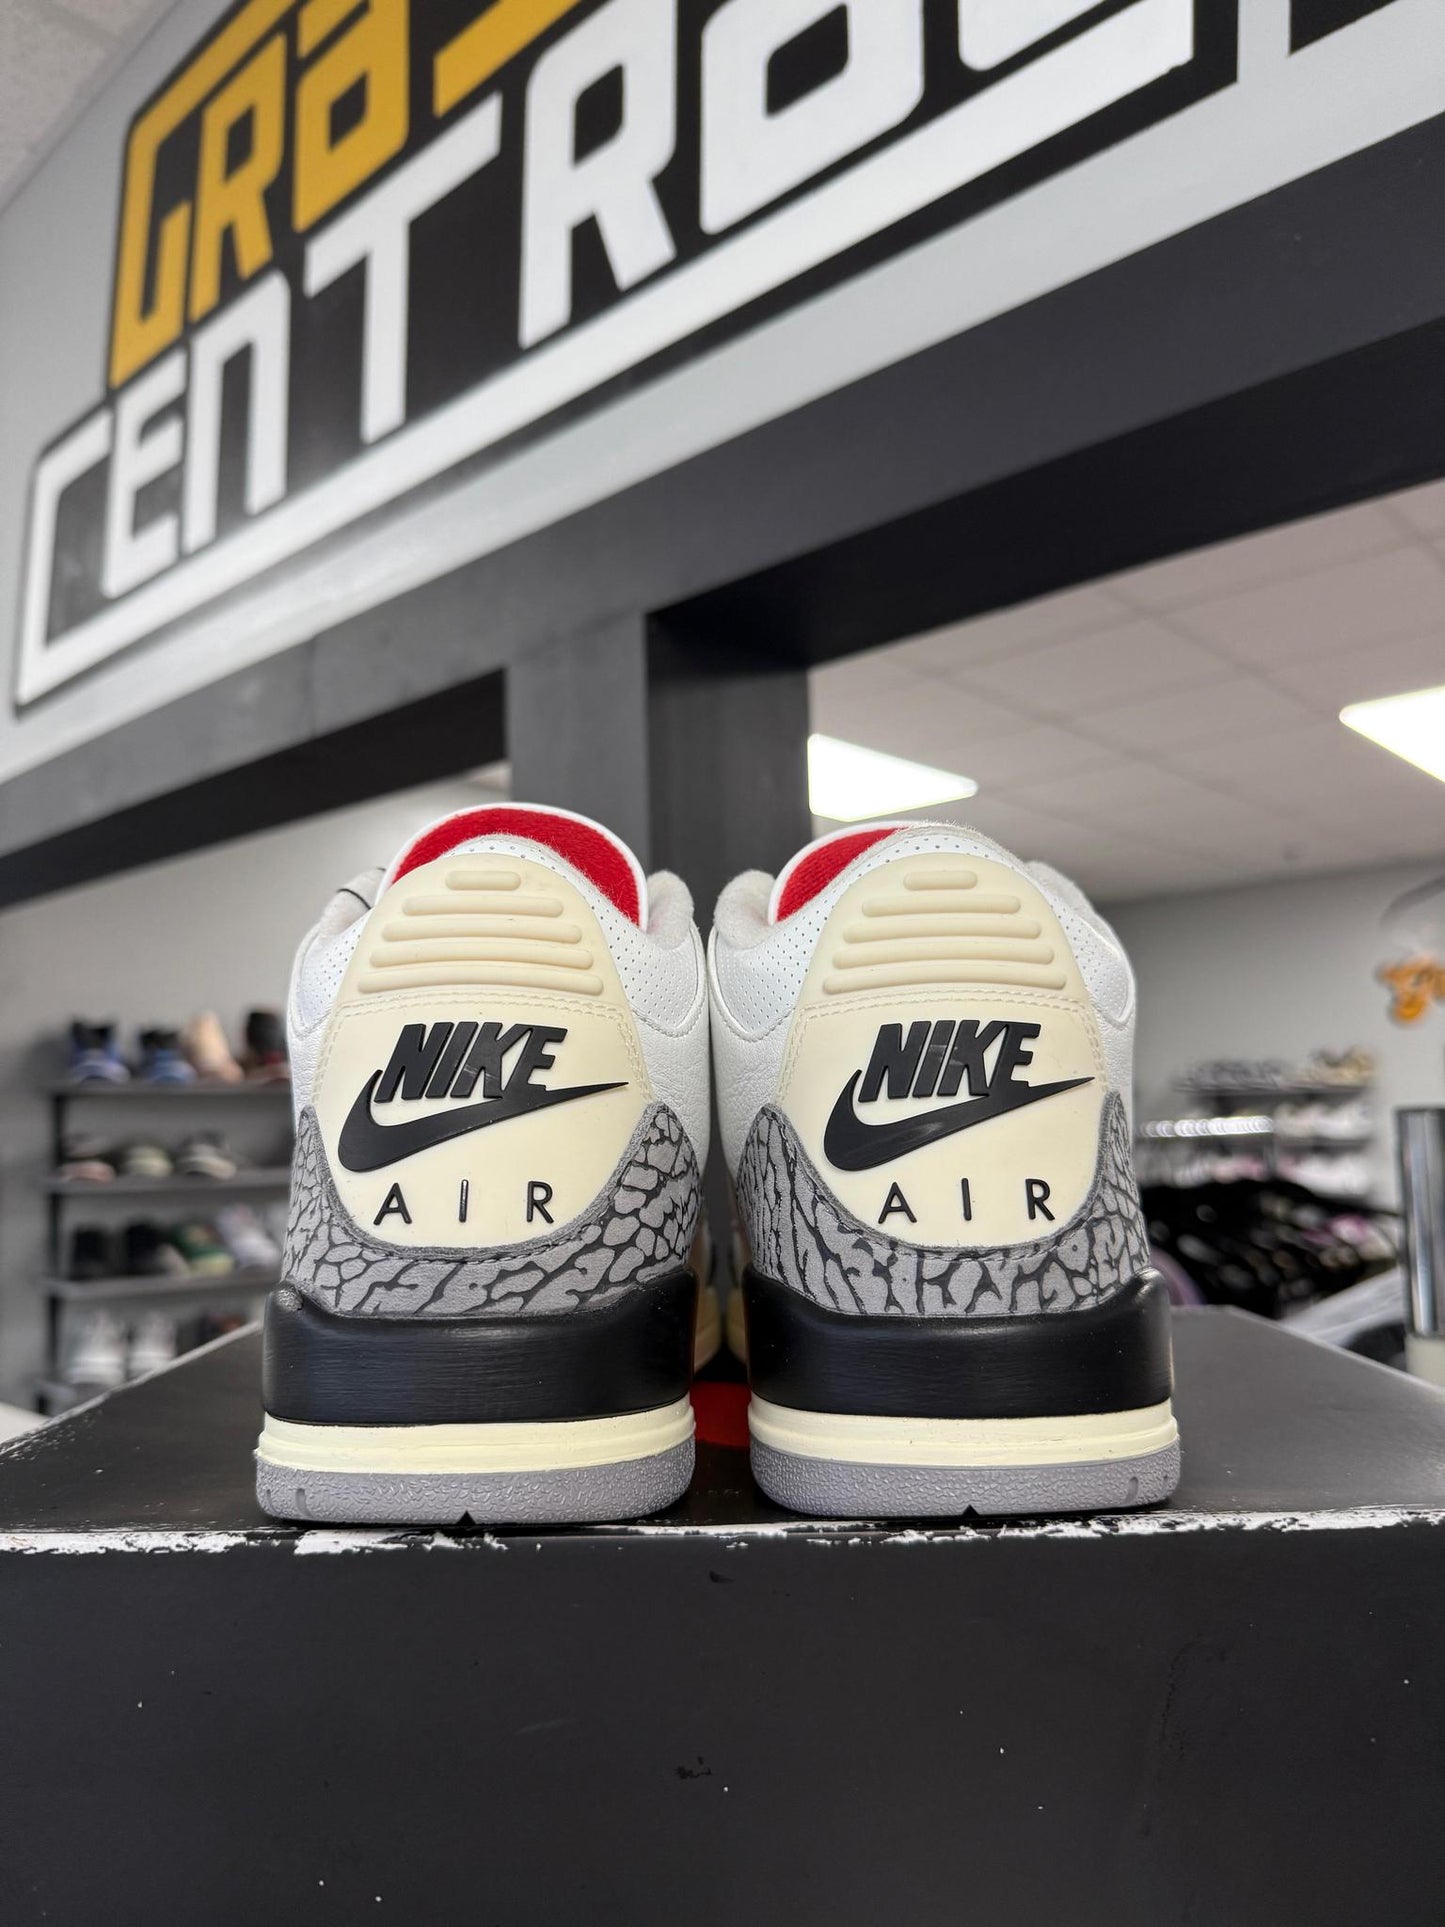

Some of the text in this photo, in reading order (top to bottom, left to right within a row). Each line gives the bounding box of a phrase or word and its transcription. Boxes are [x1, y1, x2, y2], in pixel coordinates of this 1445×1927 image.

[374, 1021, 568, 1103] NIKE
[858, 1019, 1042, 1103] NIKE
[373, 1179, 554, 1226] AIR
[878, 1177, 1056, 1224] AIR
